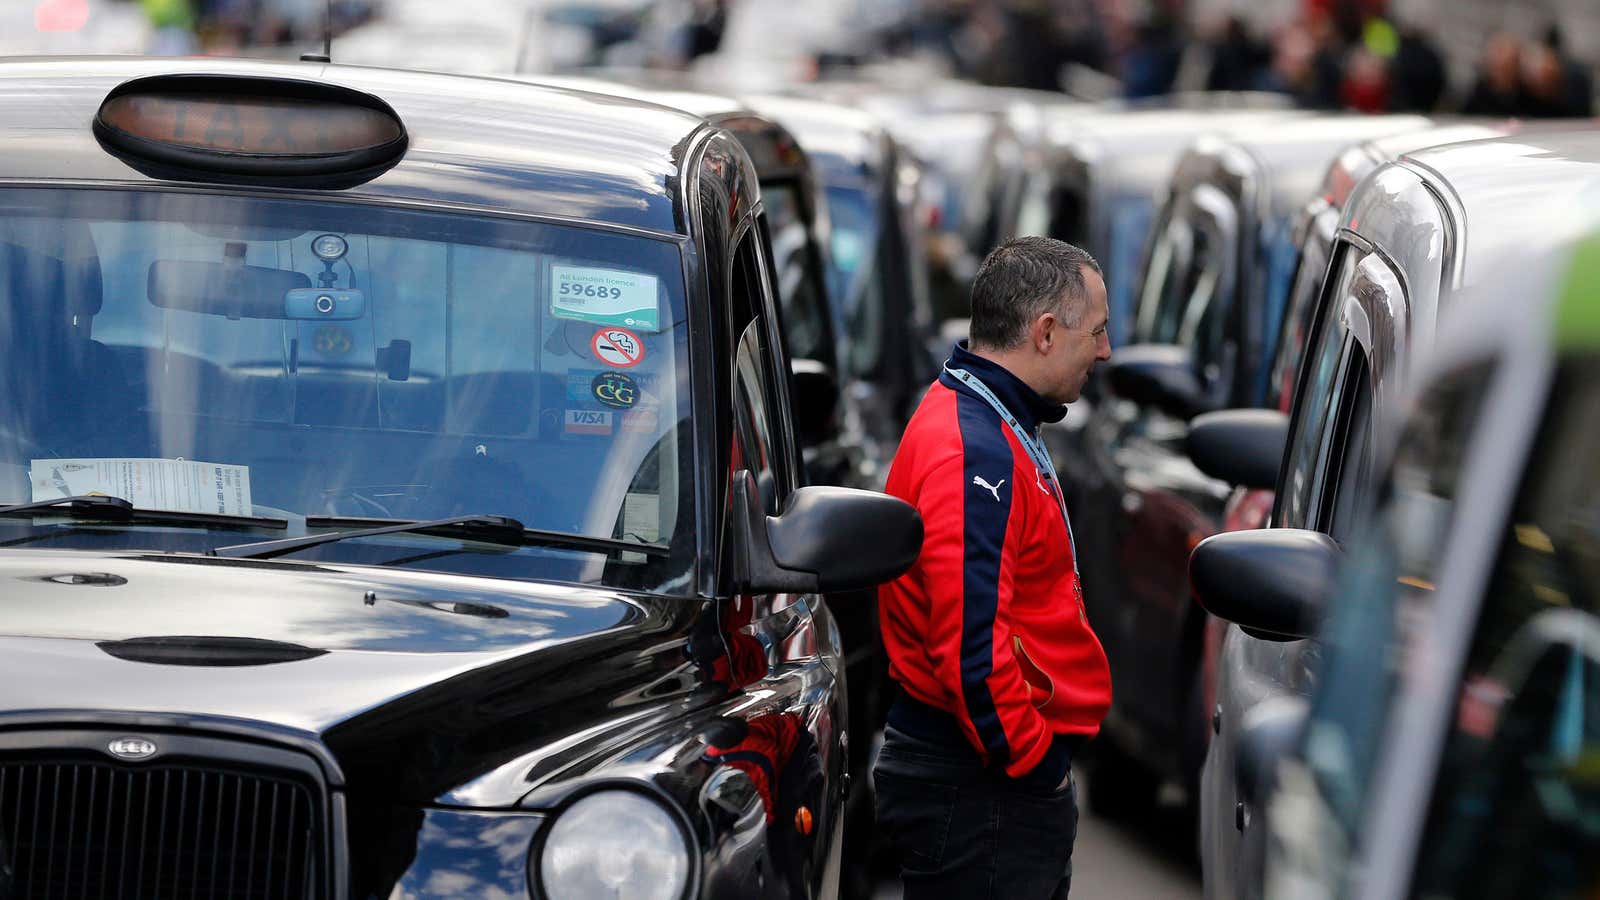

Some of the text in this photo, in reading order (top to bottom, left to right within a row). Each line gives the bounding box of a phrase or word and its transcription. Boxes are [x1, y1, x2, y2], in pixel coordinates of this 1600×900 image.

[572, 273, 605, 284] London
[606, 277, 635, 288] licence
[560, 283, 621, 299] 59689
[573, 411, 605, 424] VISA
